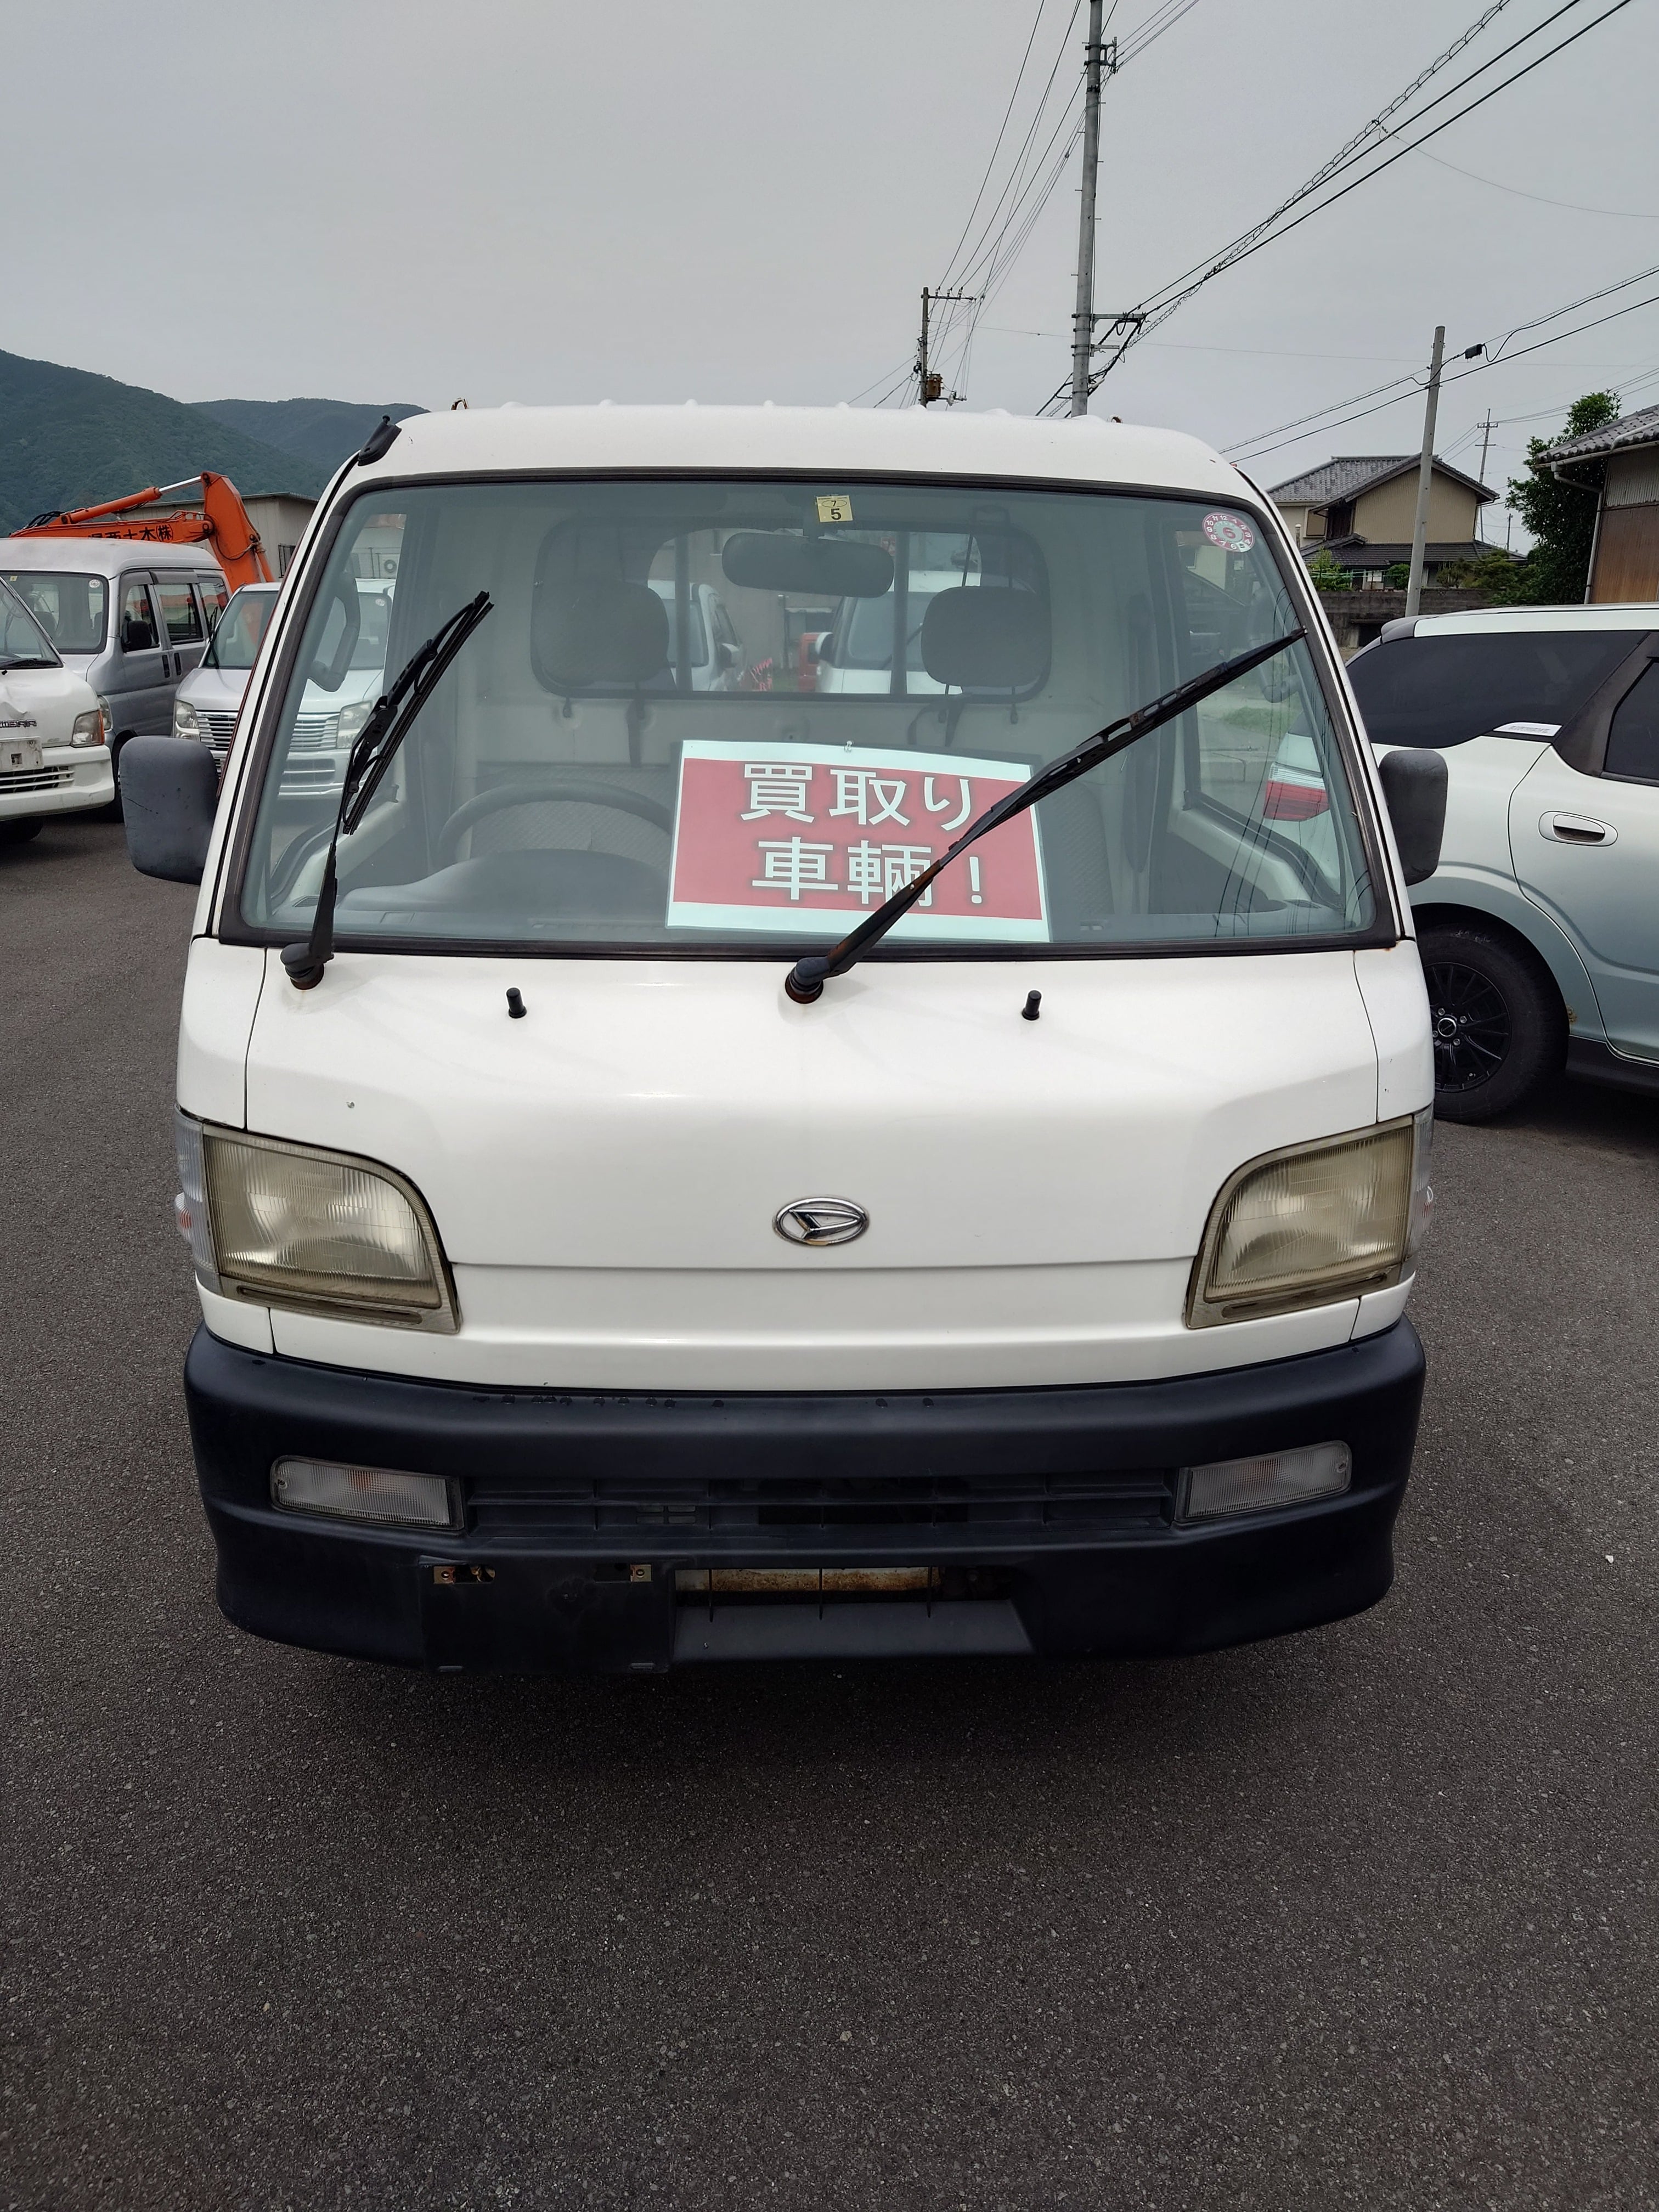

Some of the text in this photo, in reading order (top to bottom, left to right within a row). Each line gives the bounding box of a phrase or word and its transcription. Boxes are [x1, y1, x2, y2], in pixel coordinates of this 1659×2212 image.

[831, 508, 842, 520] 5
[1223, 527, 1235, 539] 6
[741, 764, 971, 831] 買取り
